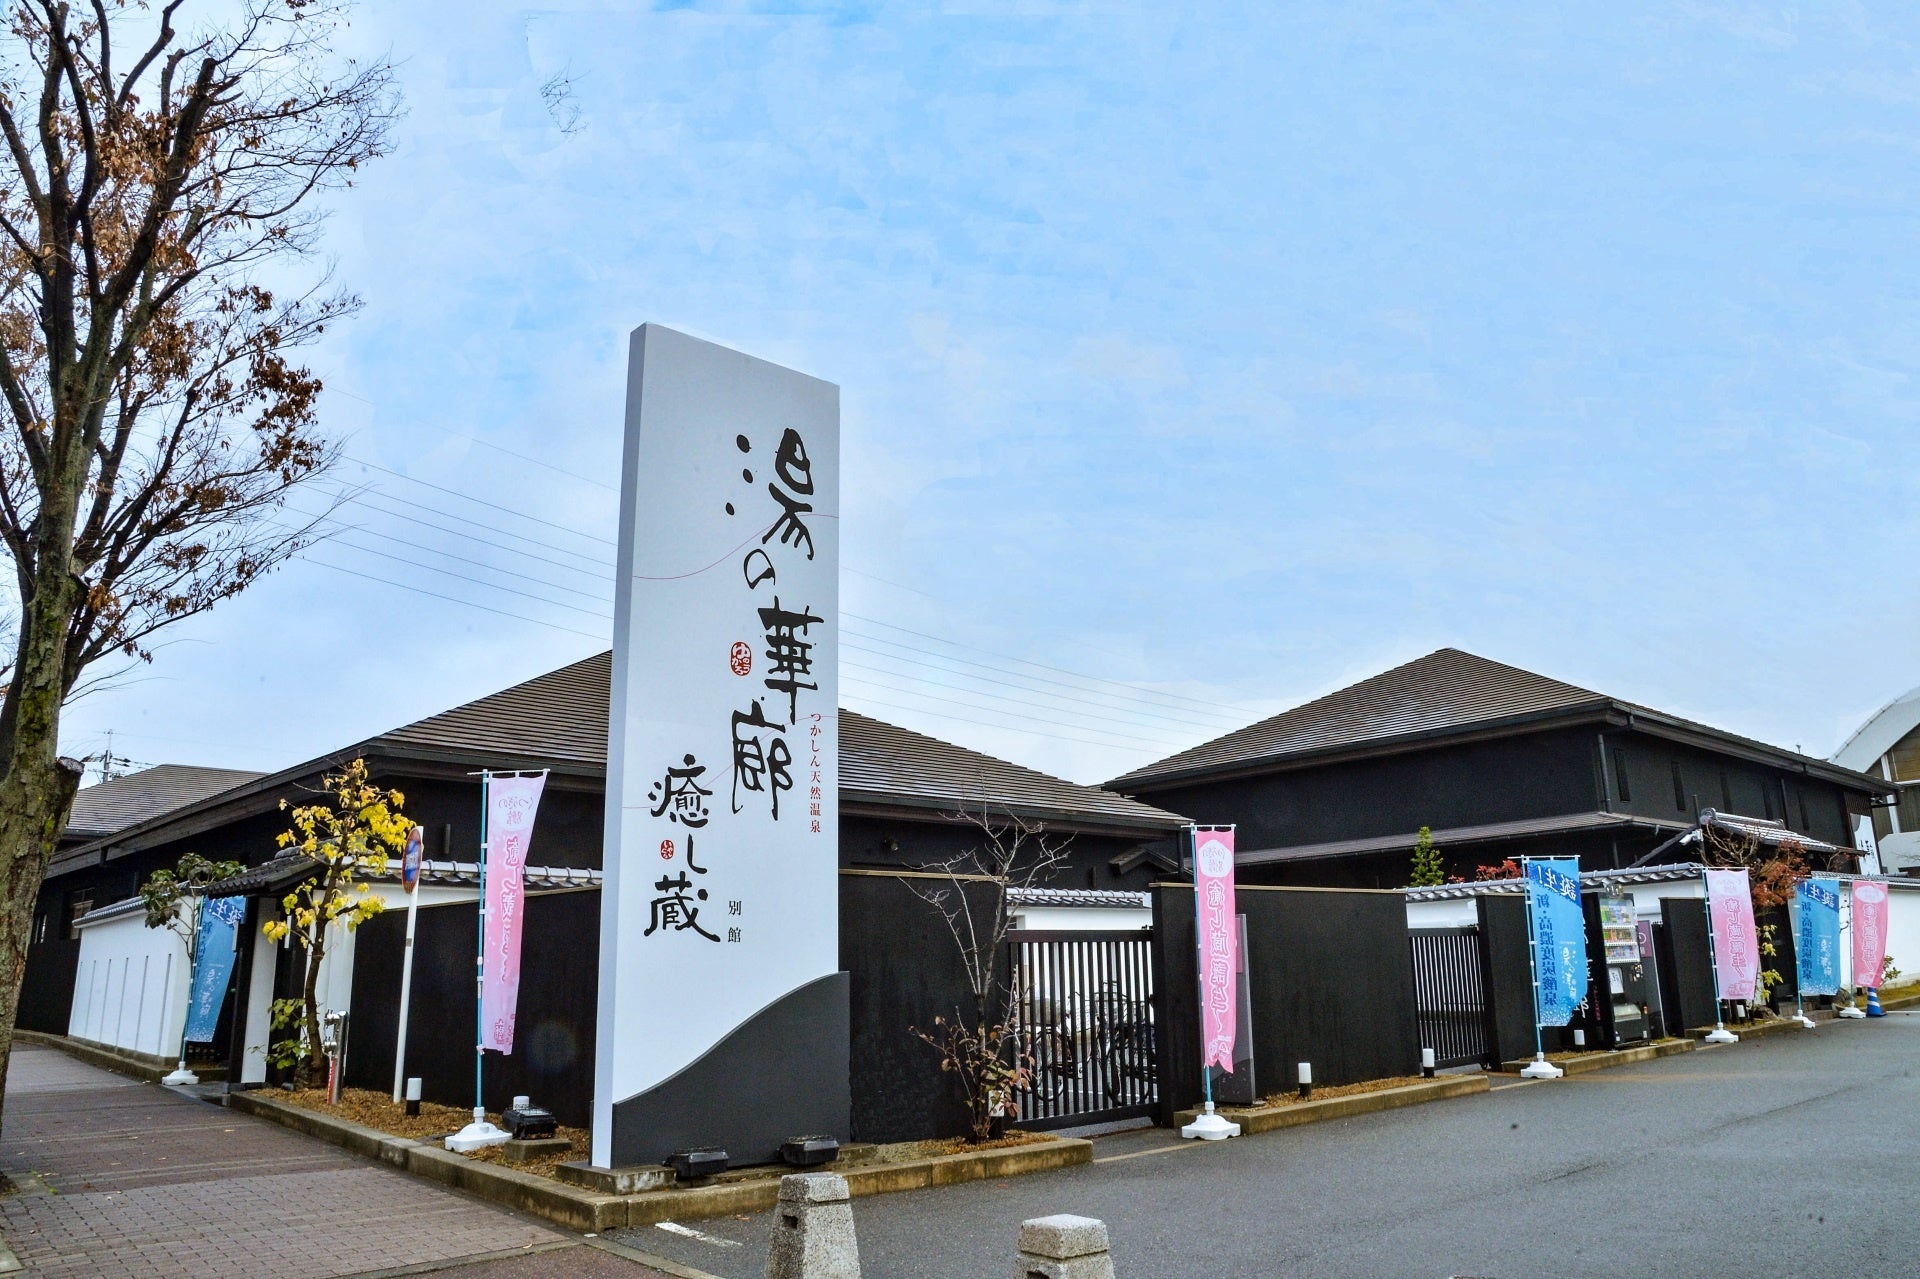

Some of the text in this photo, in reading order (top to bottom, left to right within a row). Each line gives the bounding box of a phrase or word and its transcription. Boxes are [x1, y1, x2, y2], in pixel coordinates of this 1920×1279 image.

[725, 427, 825, 821] 湯の華廊
[643, 752, 722, 943] 癒し蔵
[809, 712, 822, 834] つかしん天然温泉
[727, 899, 743, 943] 別館
